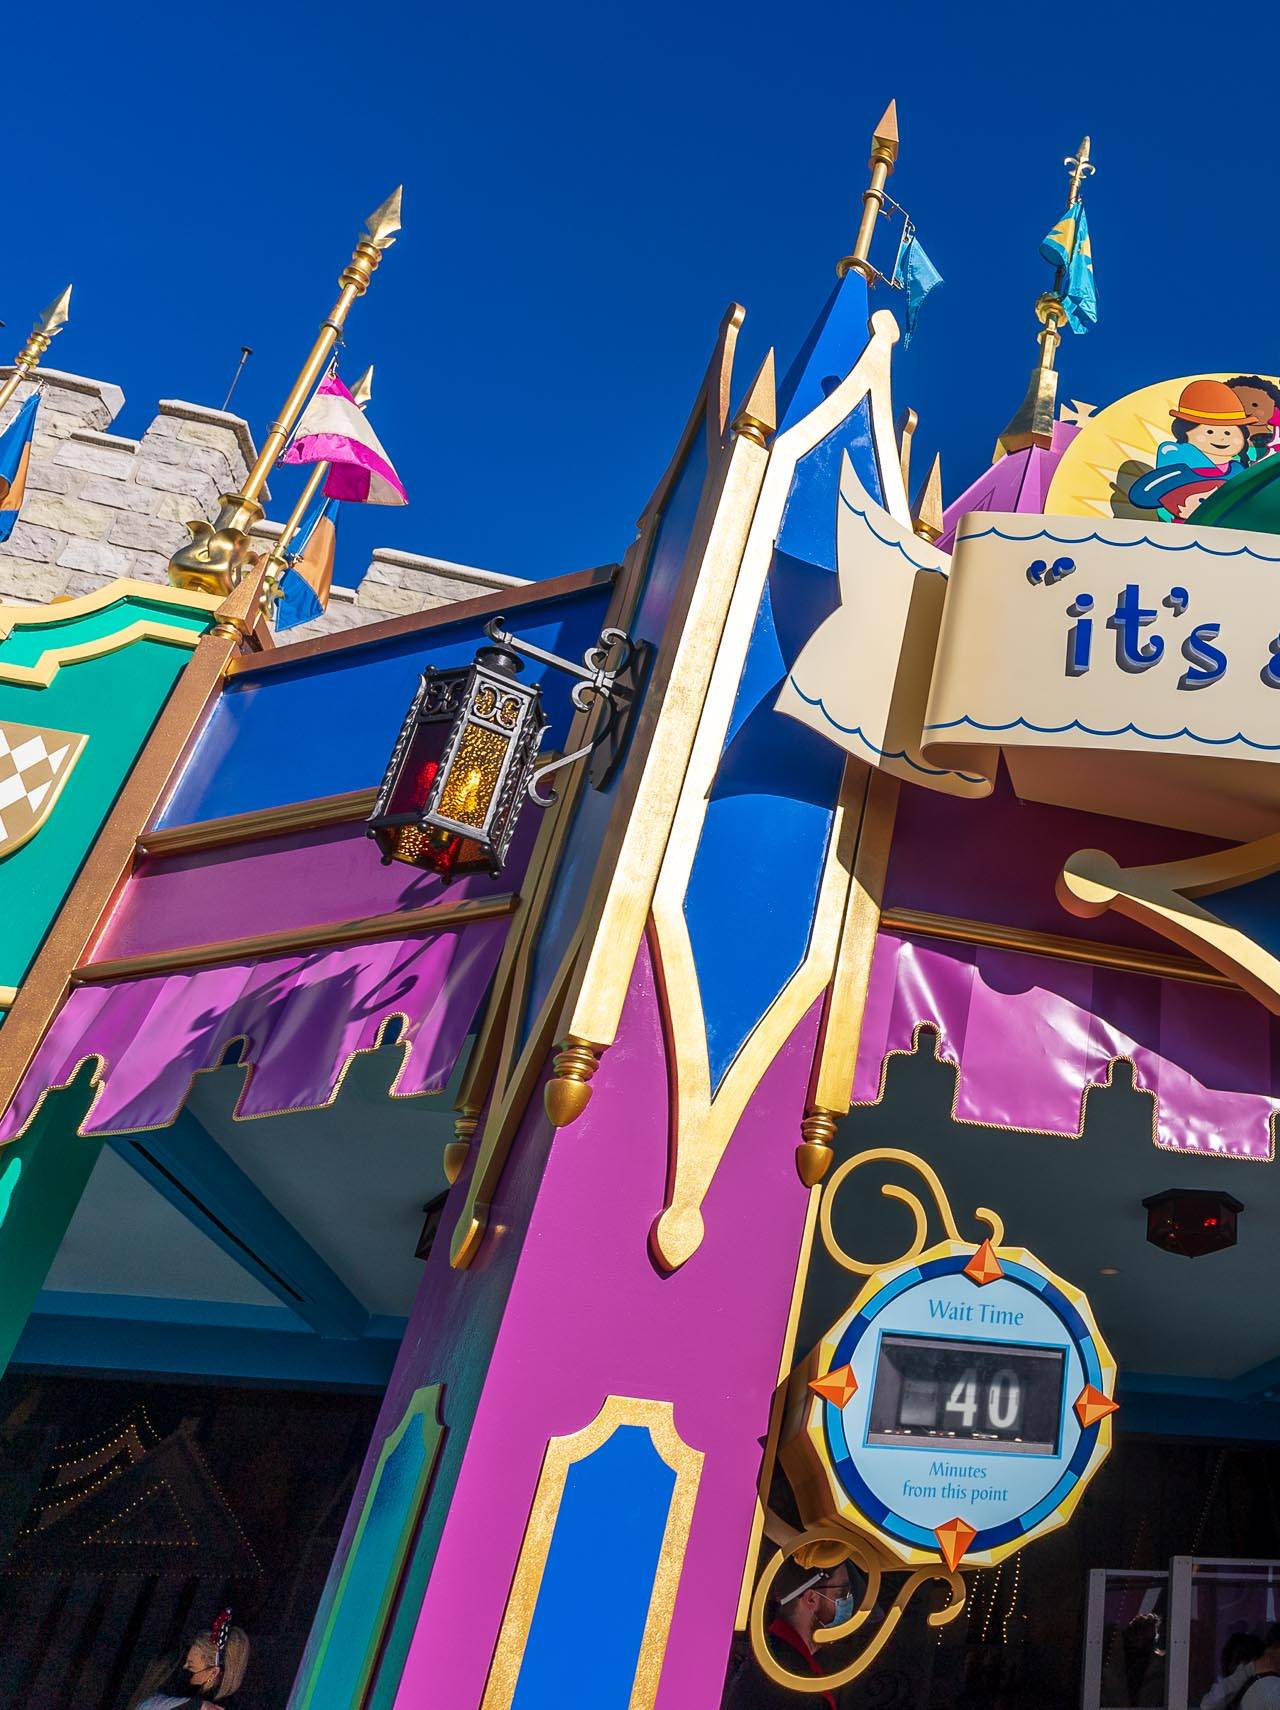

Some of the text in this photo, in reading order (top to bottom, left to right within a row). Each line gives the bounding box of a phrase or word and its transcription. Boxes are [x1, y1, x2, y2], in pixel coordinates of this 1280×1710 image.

[928, 1298, 1024, 1326] Wait Time
[946, 1367, 1021, 1428] 40
[929, 1461, 987, 1479] Minutes
[903, 1480, 1008, 1504] from this point
